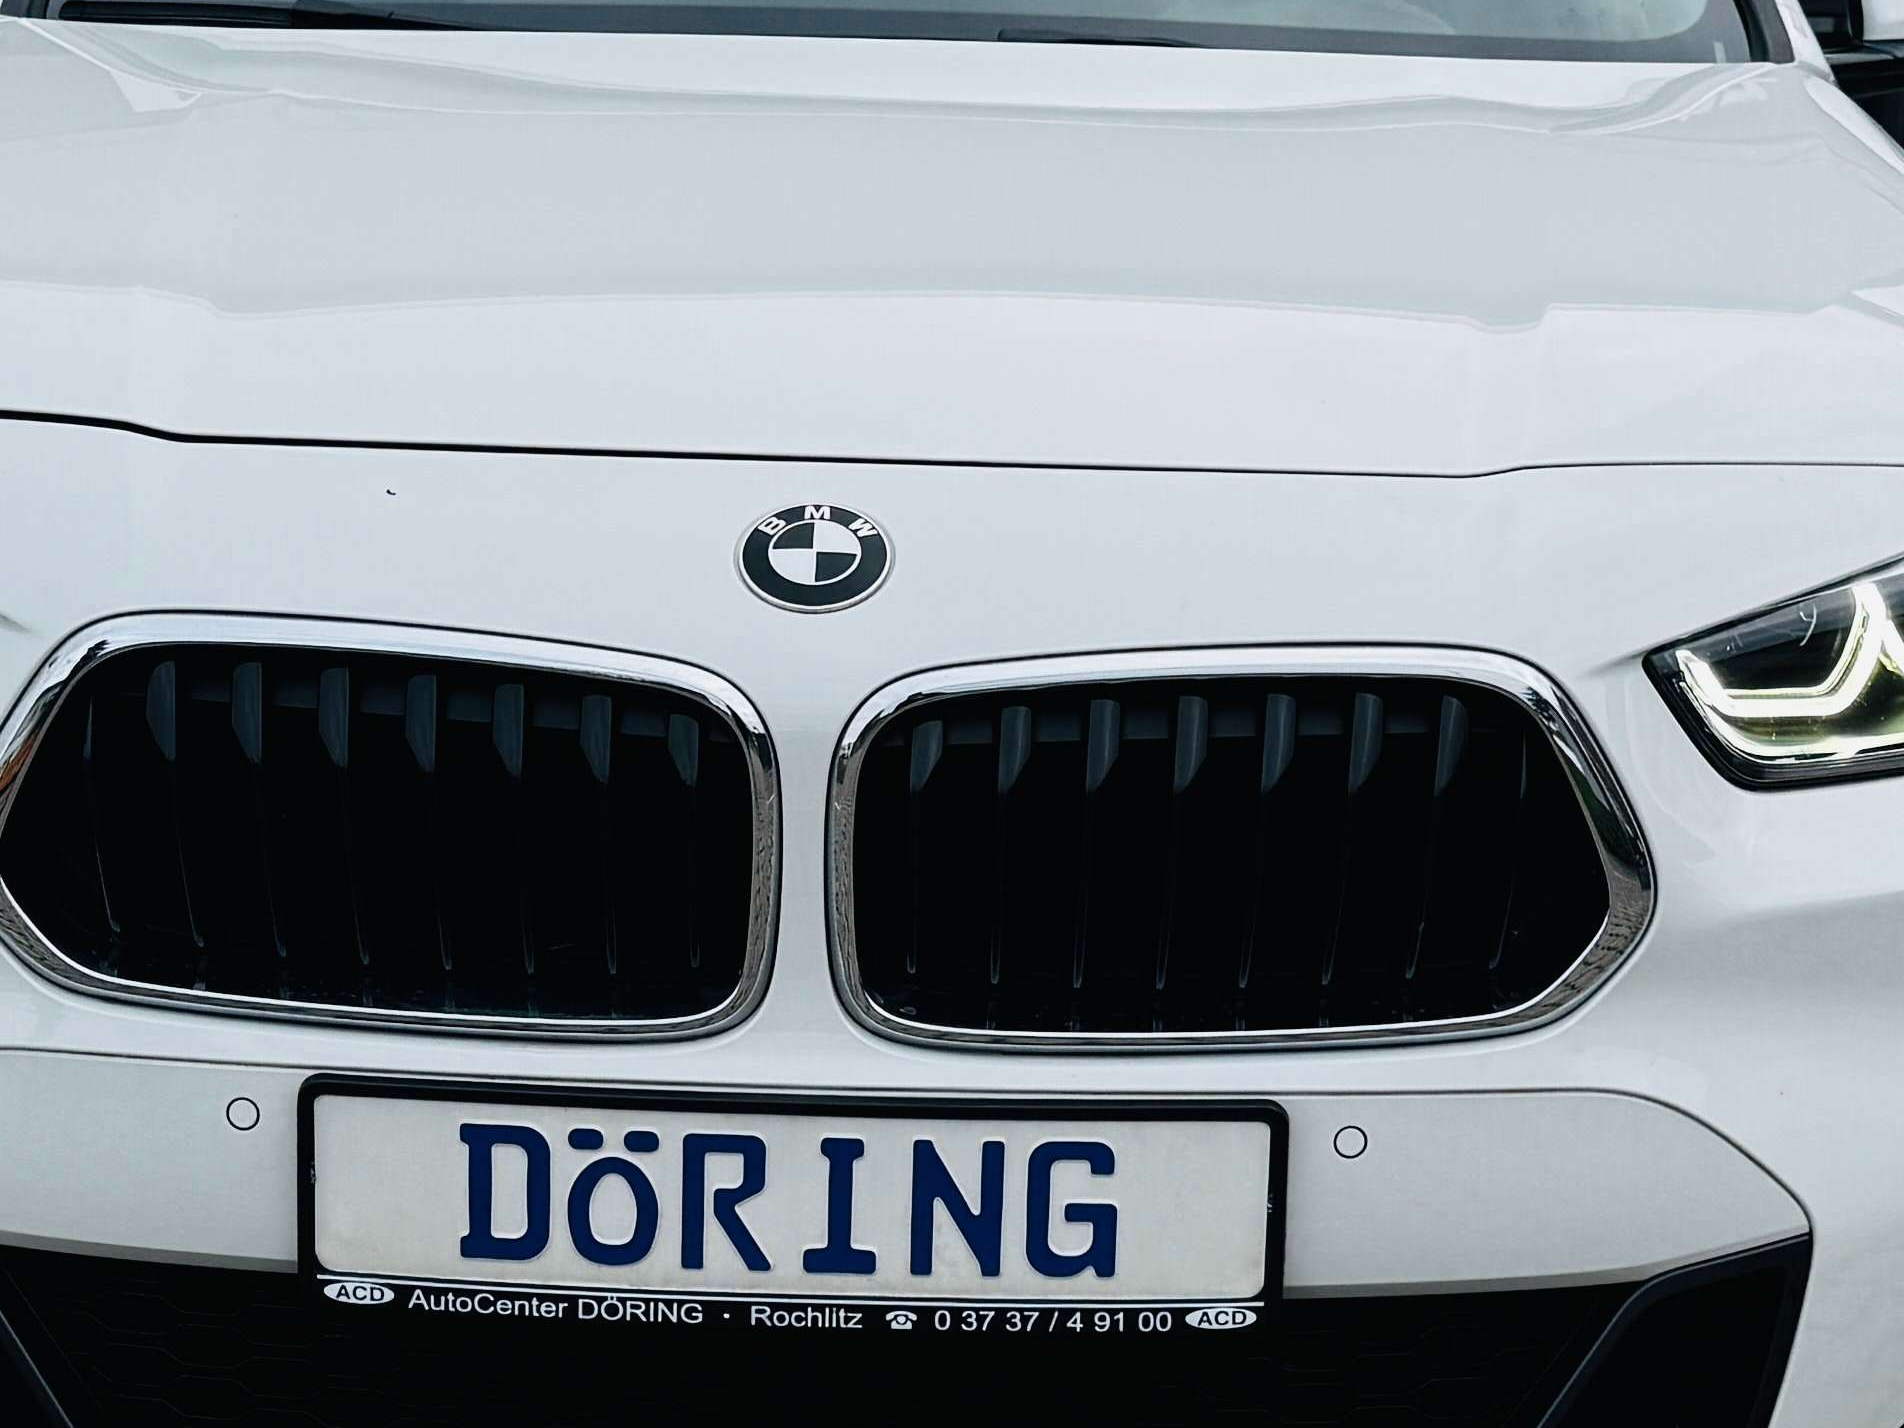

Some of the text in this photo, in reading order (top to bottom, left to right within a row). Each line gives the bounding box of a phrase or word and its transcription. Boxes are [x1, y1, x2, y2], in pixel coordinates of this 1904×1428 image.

[458, 1121, 1119, 1280] DÖRING
[334, 1284, 386, 1303] ACD
[407, 1288, 570, 1319] AutoCenter
[577, 1294, 704, 1325] DÖRING
[749, 1305, 864, 1330] Rochlitz
[960, 1309, 997, 1332] 37
[1004, 1310, 1041, 1333] 37
[1065, 1310, 1085, 1334] 4
[1093, 1310, 1125, 1333] 91
[1137, 1310, 1173, 1333] 00
[1195, 1308, 1248, 1327] ACD
